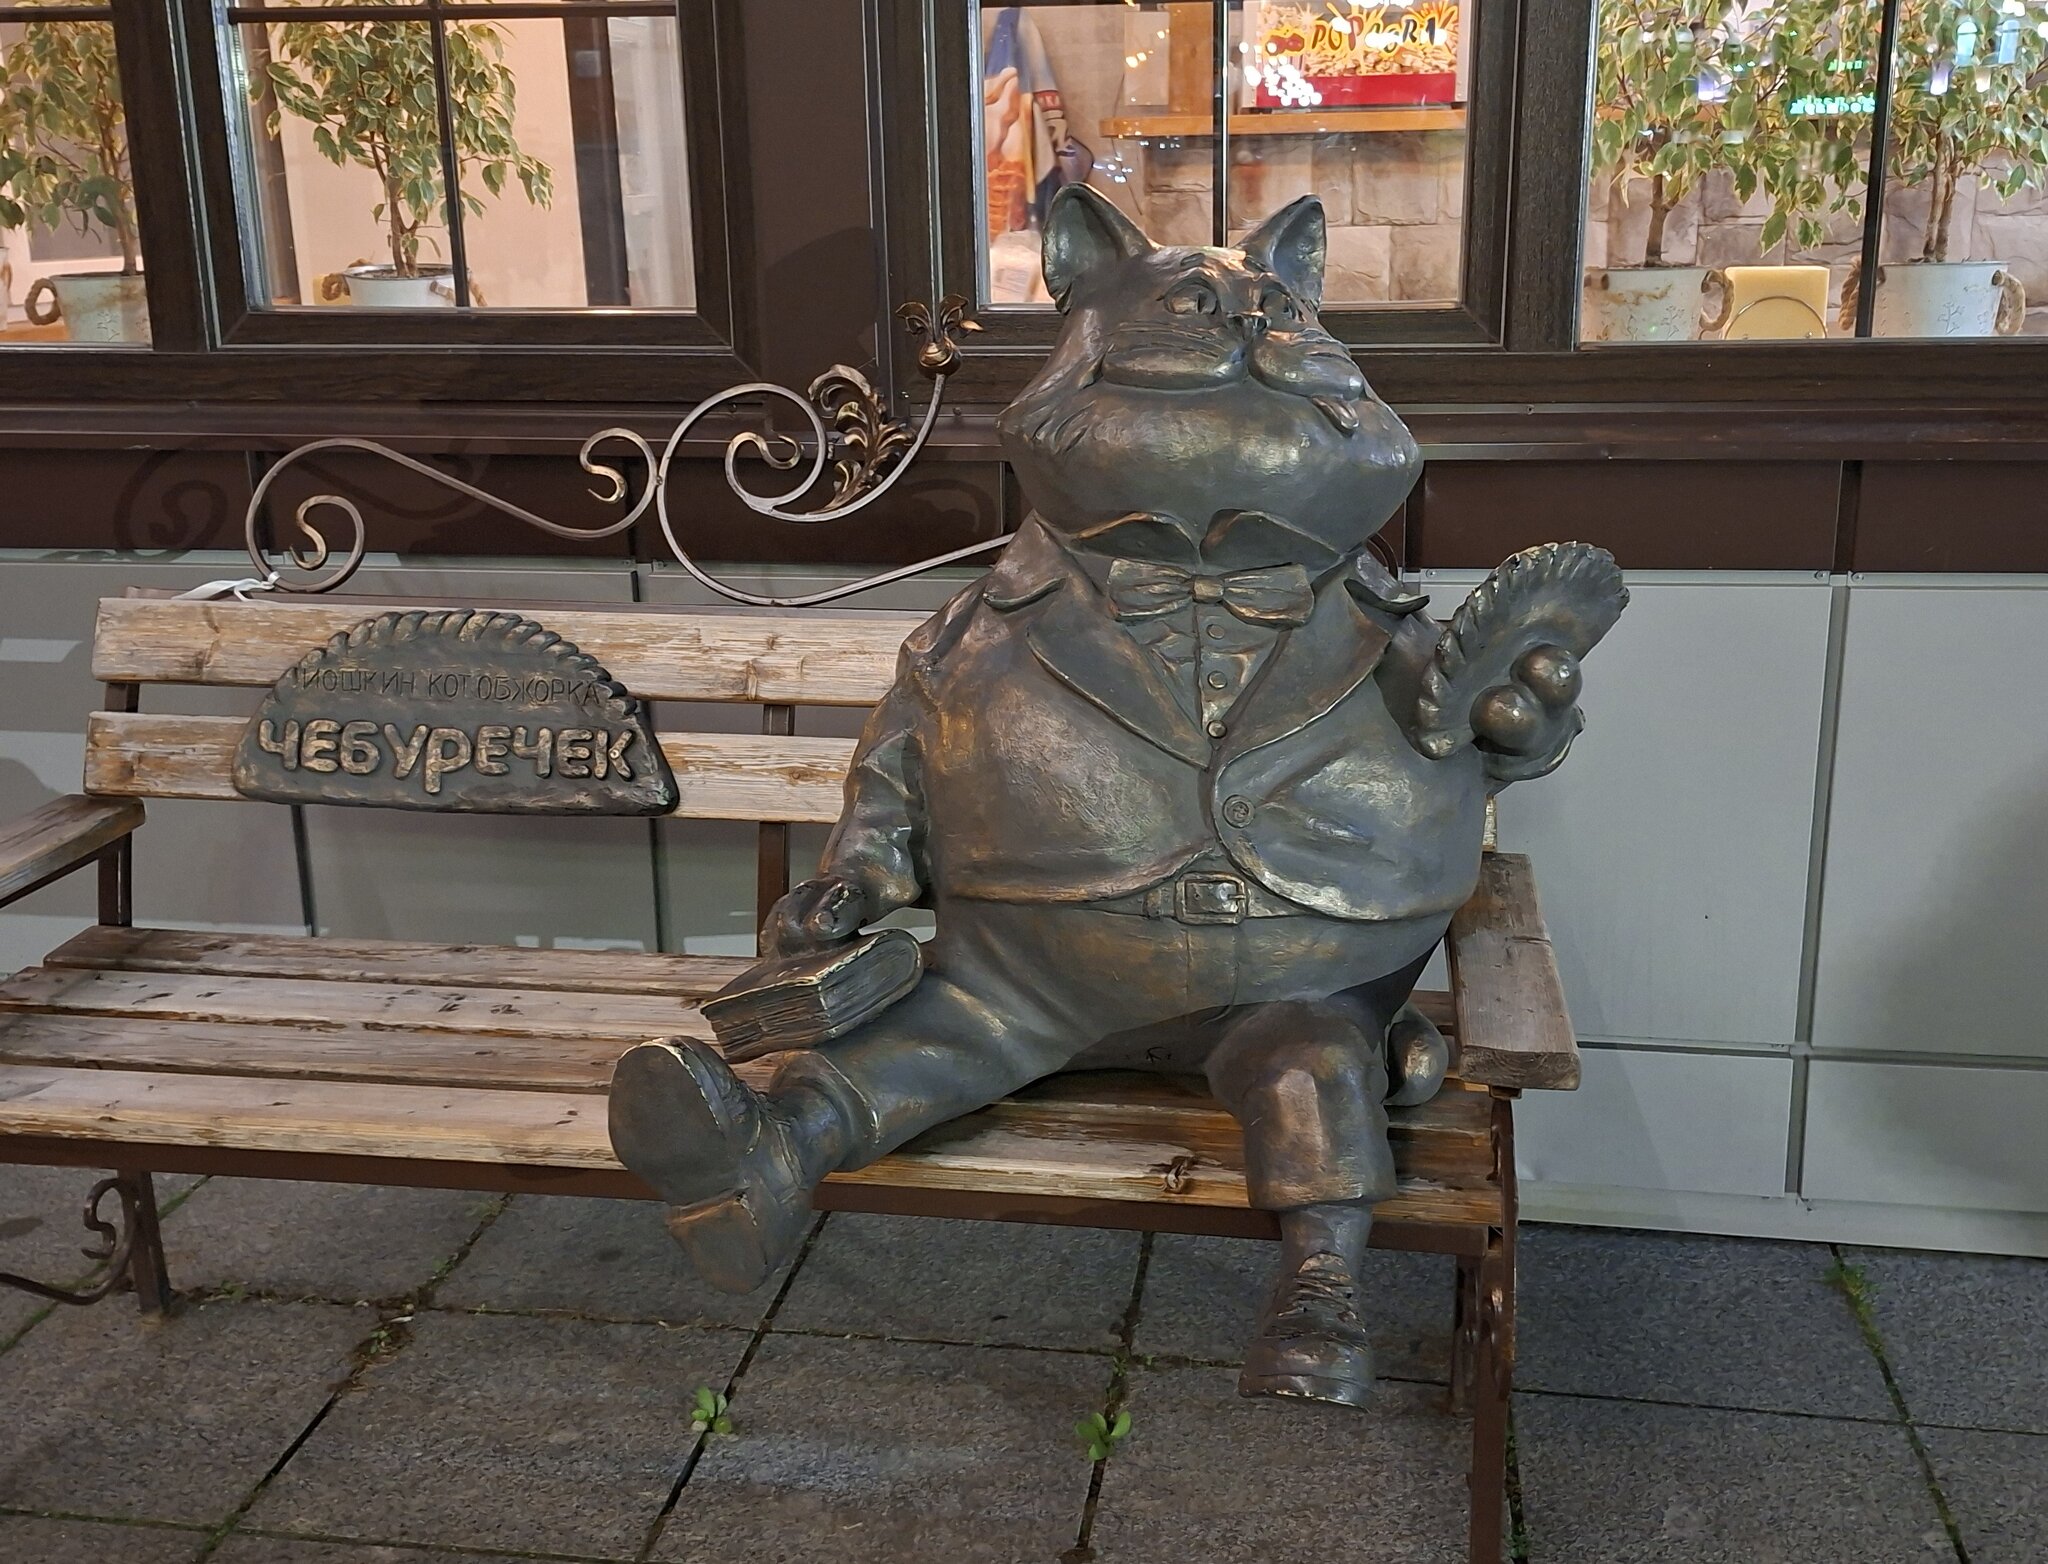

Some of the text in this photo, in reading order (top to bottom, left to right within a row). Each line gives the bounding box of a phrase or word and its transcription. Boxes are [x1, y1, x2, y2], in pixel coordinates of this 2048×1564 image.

[429, 673, 471, 698] КОТ
[477, 677, 601, 706] ОБЖОРКА
[258, 718, 634, 794] ЧЕБУРЕЧЕК
